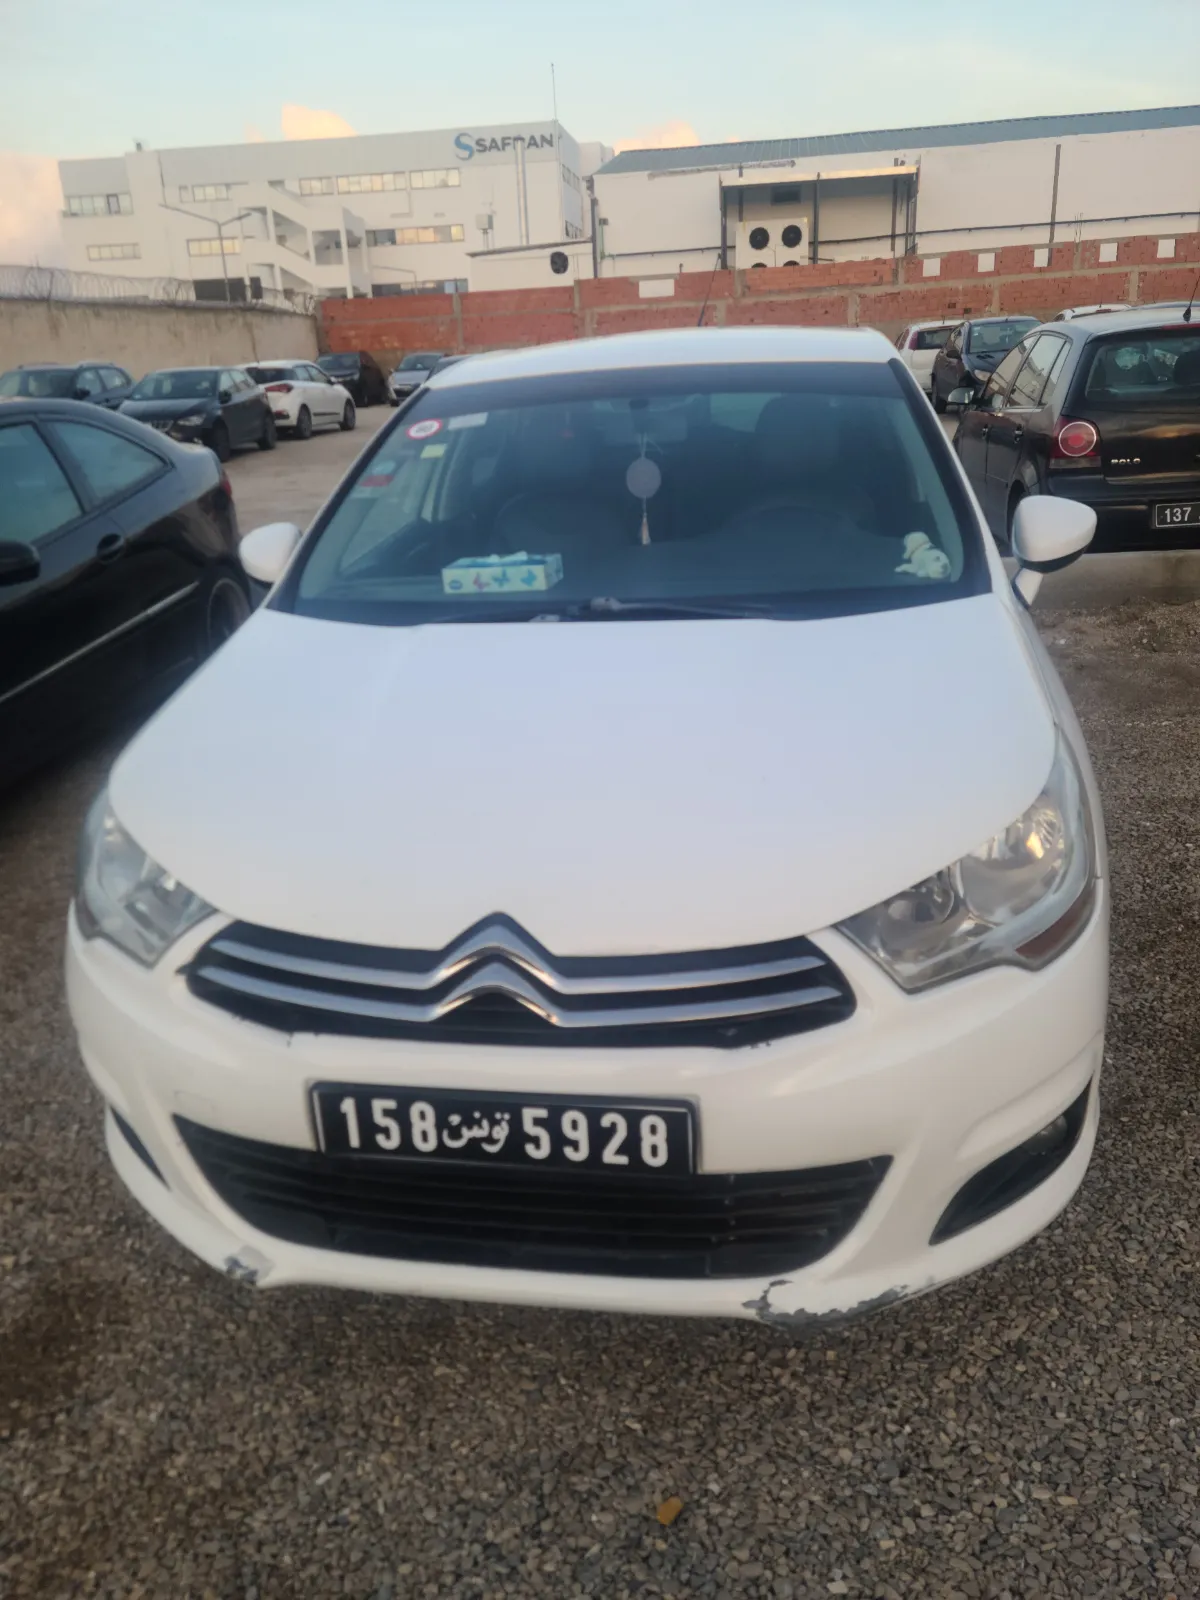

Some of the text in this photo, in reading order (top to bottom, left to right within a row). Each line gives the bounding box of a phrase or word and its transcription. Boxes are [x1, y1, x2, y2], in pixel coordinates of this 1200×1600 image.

[1164, 507, 1192, 523] 137
[340, 1096, 669, 1168] 158 تونس 5928
